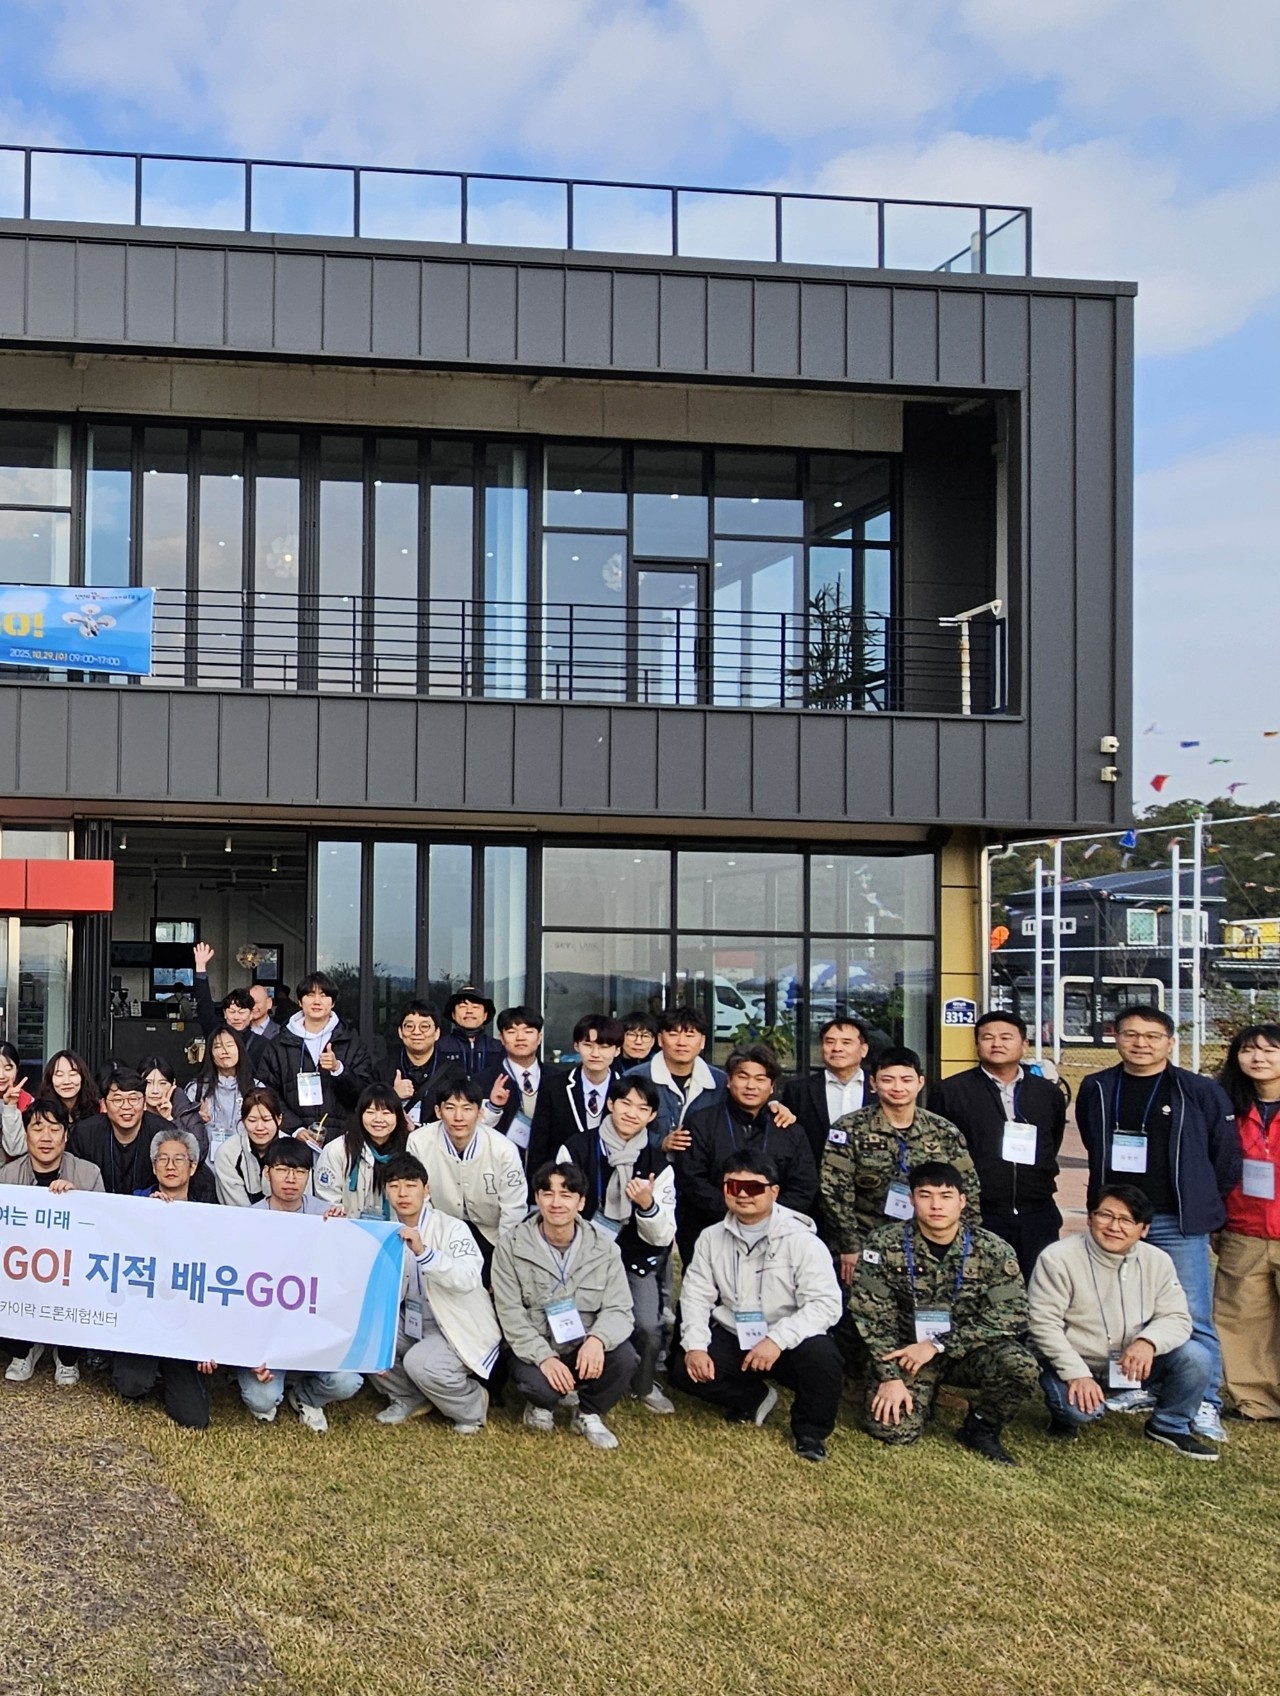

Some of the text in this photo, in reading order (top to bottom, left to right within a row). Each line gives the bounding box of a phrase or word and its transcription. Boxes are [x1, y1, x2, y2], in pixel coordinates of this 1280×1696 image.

[946, 1012, 974, 1023] 331-2
[35, 1209, 70, 1230] 미래
[449, 1239, 477, 1258] 22
[85, 1252, 156, 1298] 지적
[171, 1262, 318, 1314] 배우GO!
[39, 1306, 117, 1327] 드론체험센터
